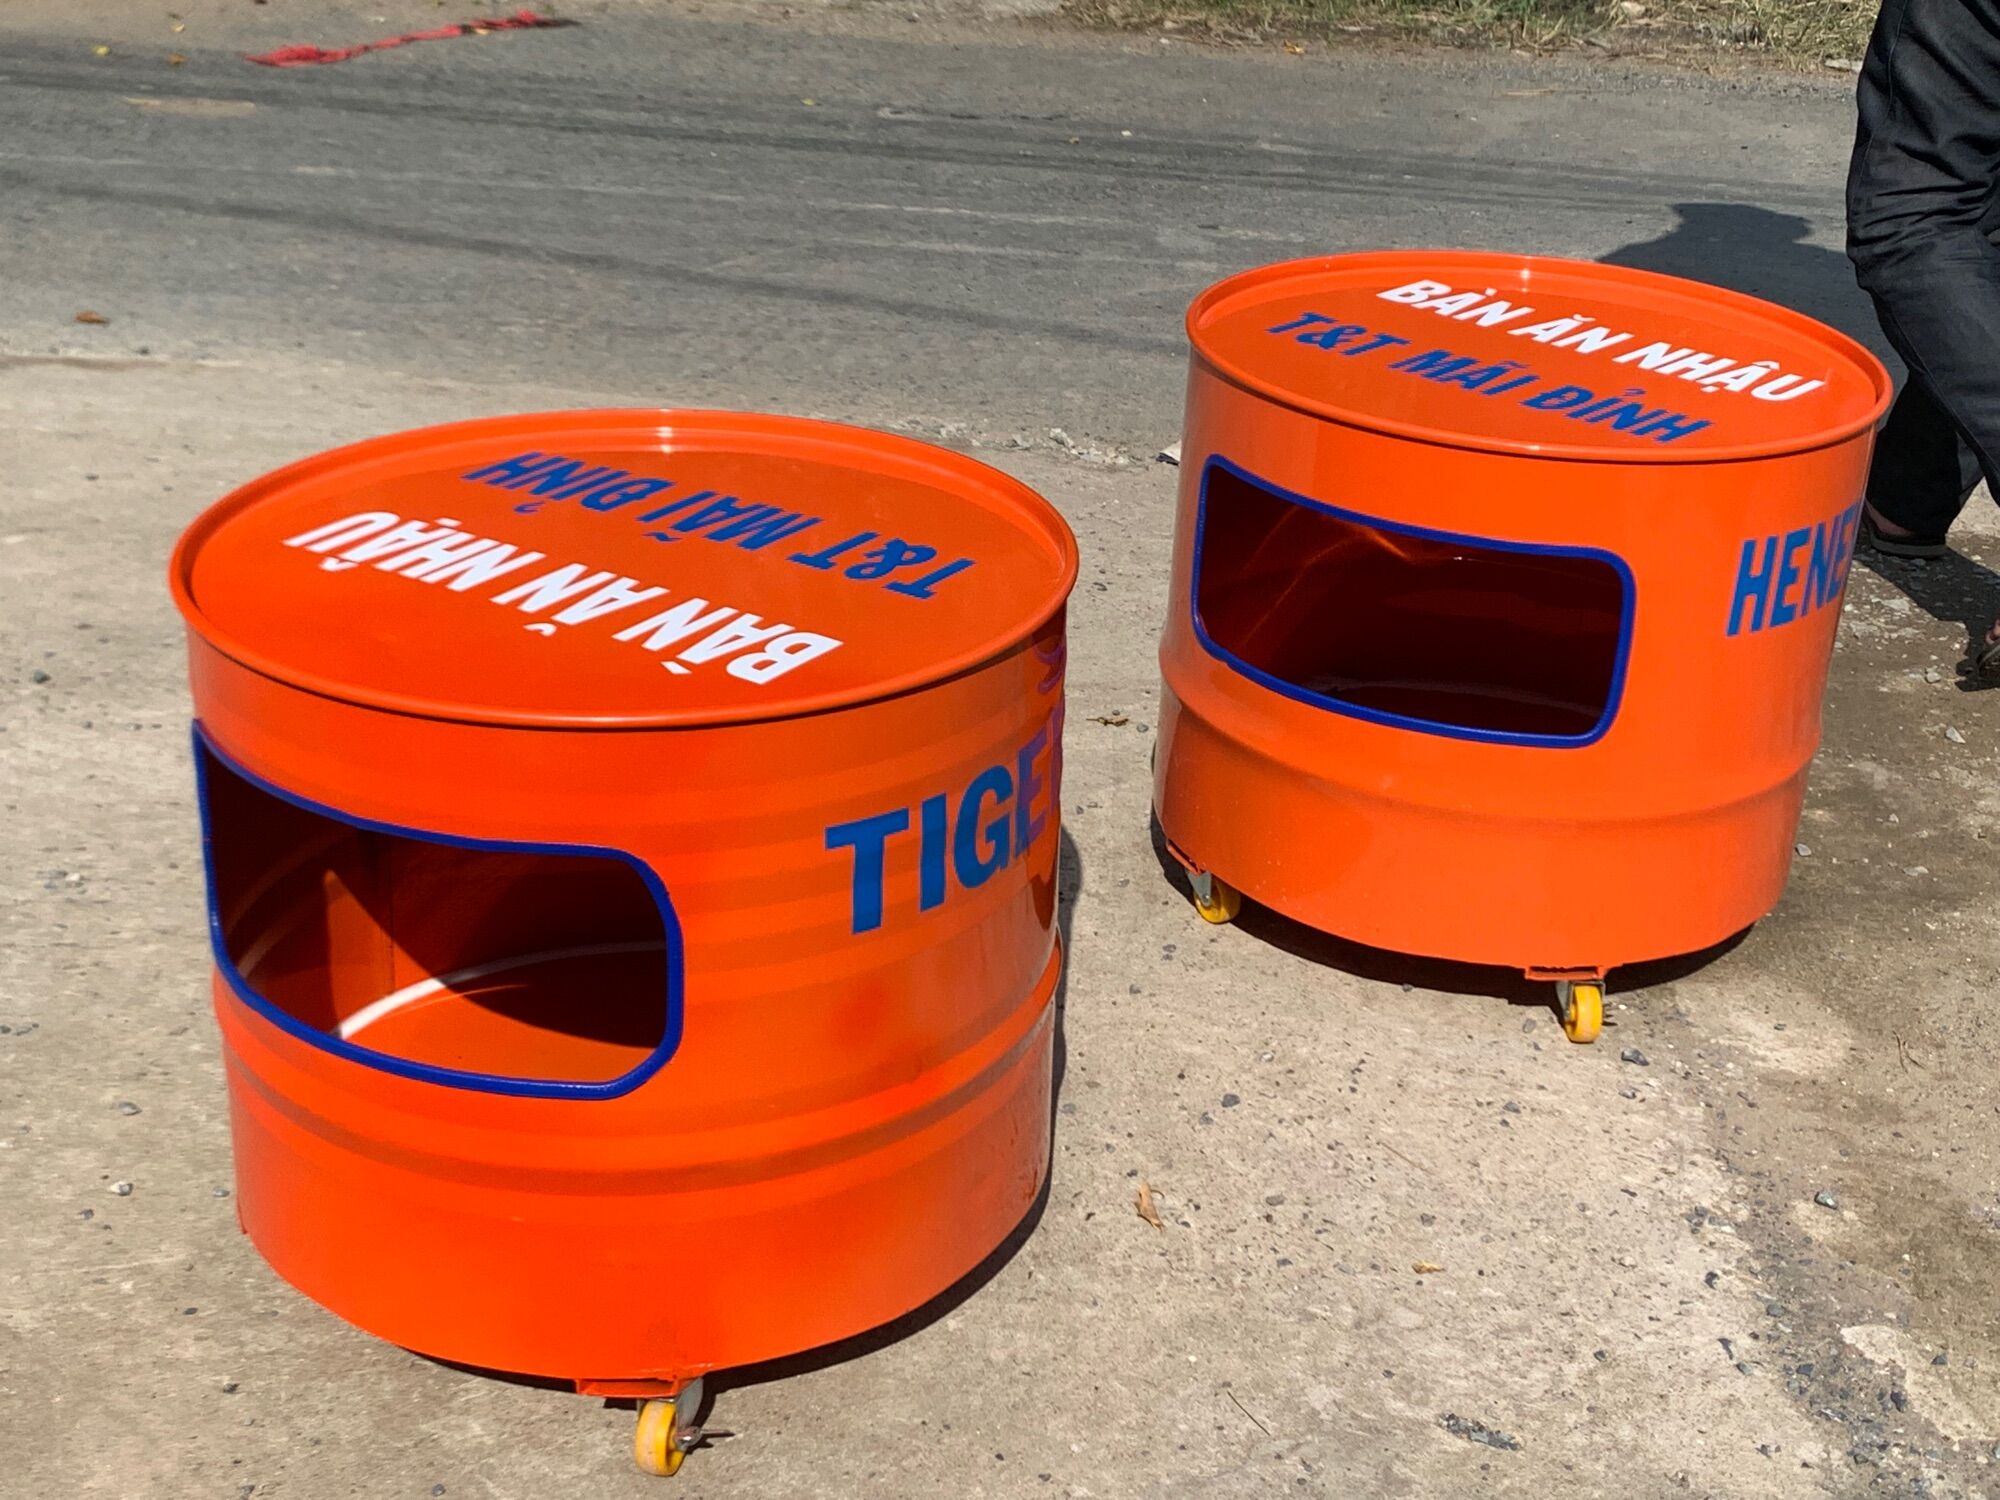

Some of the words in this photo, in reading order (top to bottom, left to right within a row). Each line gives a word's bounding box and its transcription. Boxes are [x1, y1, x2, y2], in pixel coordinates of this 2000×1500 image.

[1266, 311, 1412, 356] T&T
[1388, 349, 1541, 396] MÃI
[1520, 385, 1713, 442] ĐỈNH
[1376, 279, 1535, 327] BÀN
[1506, 312, 1635, 354] ĂN
[1611, 341, 1827, 402] NHẬU
[464, 451, 675, 515] ĐỈNH
[638, 490, 820, 551] MÃI
[283, 511, 545, 592] NHẬU
[788, 532, 977, 600] T&T
[492, 563, 669, 636] ĂN
[612, 597, 844, 686] BÀN
